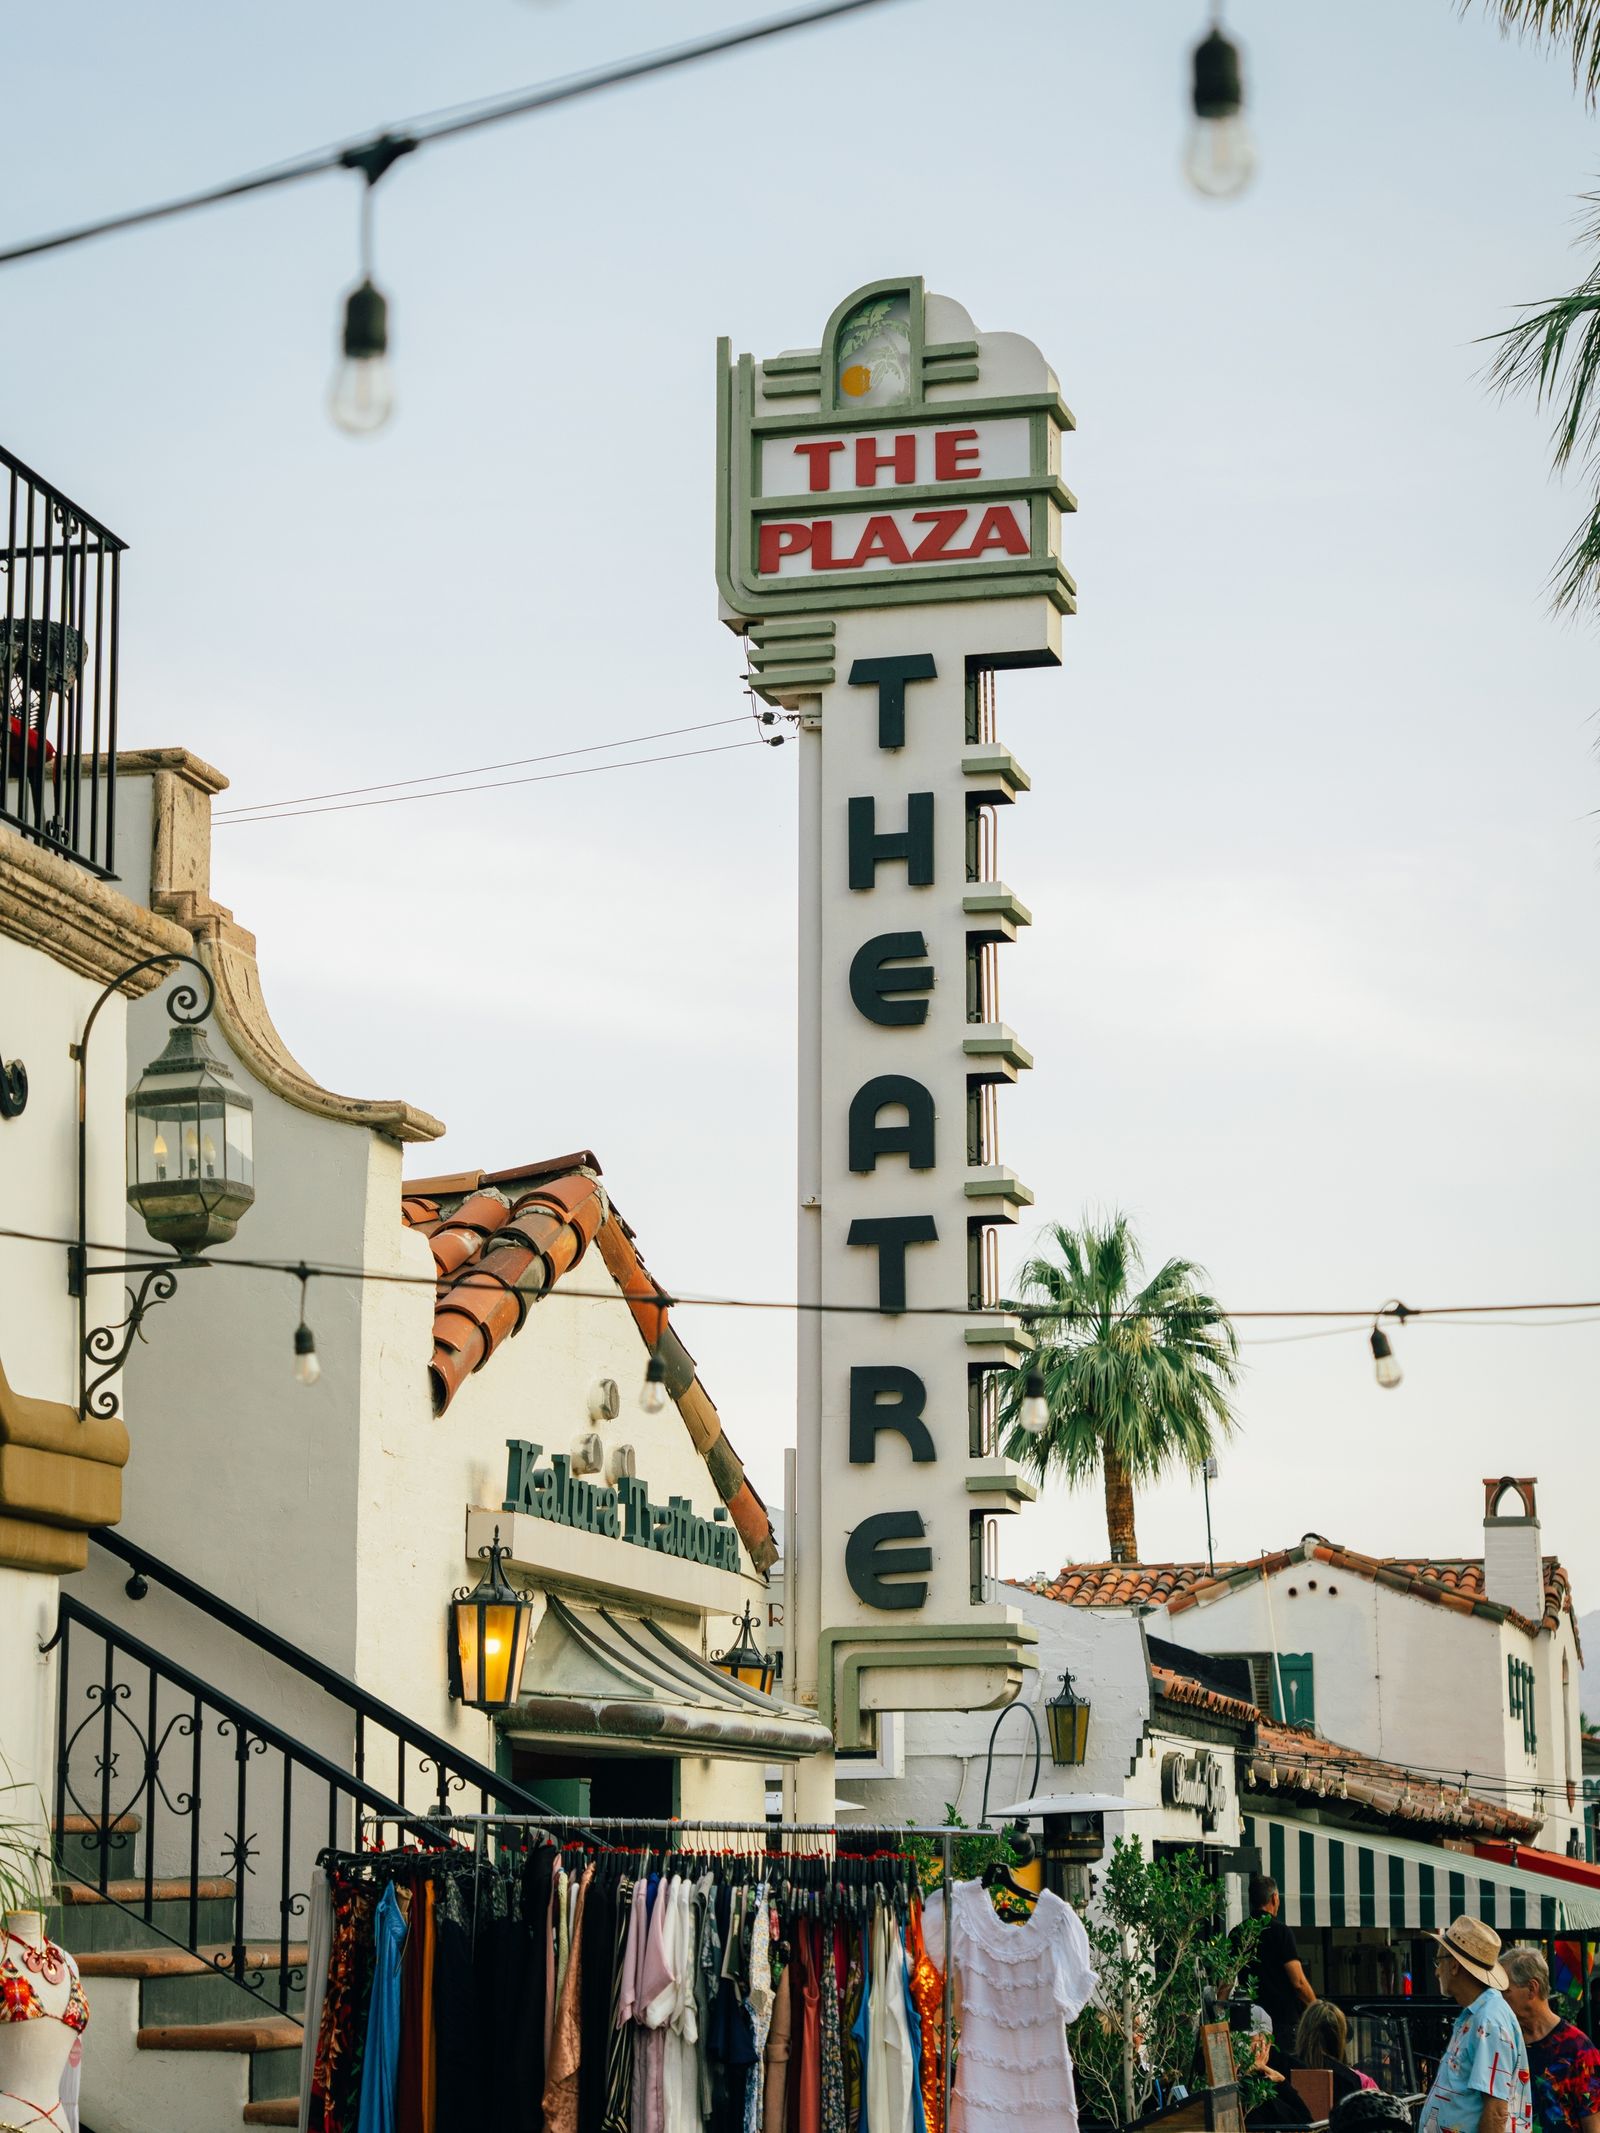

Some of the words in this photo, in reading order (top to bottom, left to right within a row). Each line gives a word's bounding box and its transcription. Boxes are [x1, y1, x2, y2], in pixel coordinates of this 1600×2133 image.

[793, 429, 981, 491] THE
[759, 506, 1030, 574] PLAZA
[845, 653, 939, 1610] THEATRE
[502, 1439, 621, 1540] Kalura
[618, 1476, 741, 1574] Trattoria
